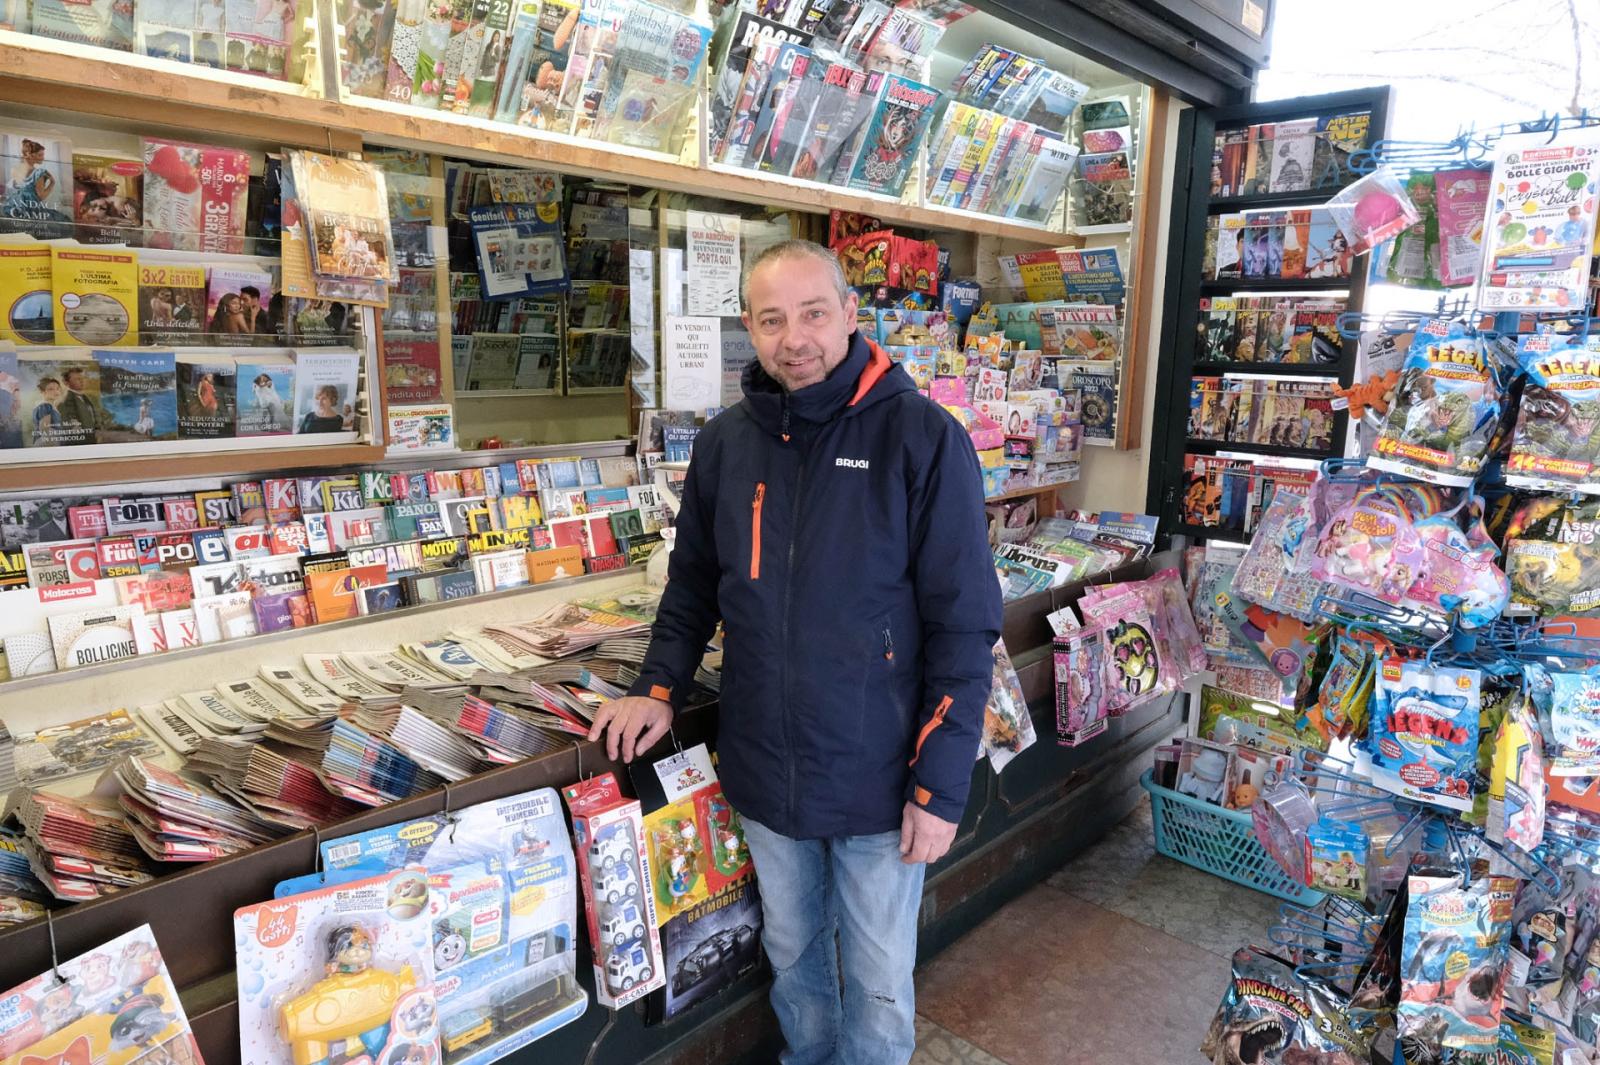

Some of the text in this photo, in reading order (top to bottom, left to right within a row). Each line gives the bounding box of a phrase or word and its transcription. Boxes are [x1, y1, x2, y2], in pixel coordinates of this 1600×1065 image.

[493, 2, 509, 15] 22
[389, 85, 411, 100] 40
[1327, 116, 1370, 130] MISTER
[1329, 125, 1368, 141] NO
[1507, 162, 1591, 179] BOLLE GIGANTI
[1508, 181, 1565, 206] crystal
[1547, 187, 1581, 206] ball
[697, 253, 732, 265] PORTA QUI
[142, 269, 166, 285] 3x2
[169, 276, 200, 286] GRATIS
[684, 324, 711, 332] VENDITA
[1428, 345, 1487, 374] LEGEN
[1073, 376, 1111, 388] OROSCOPO
[835, 457, 869, 469] BRUGI
[43, 586, 92, 598] Motocross
[76, 640, 136, 665] BOLLICINE
[1458, 677, 1470, 688] 15
[1387, 708, 1470, 745] LEGEND
[497, 797, 549, 816] IMPERDIBILE
[505, 808, 539, 823] NUMERO
[688, 889, 744, 923] BATMOBILE
[269, 916, 285, 931] 44
[259, 924, 292, 943] Gatti
[617, 985, 649, 1005] DIE-CAST
[1237, 979, 1312, 1020] DINOSAUR PARK
[1249, 999, 1298, 1022] MEGA PACK
[1320, 1018, 1333, 1033] 3
